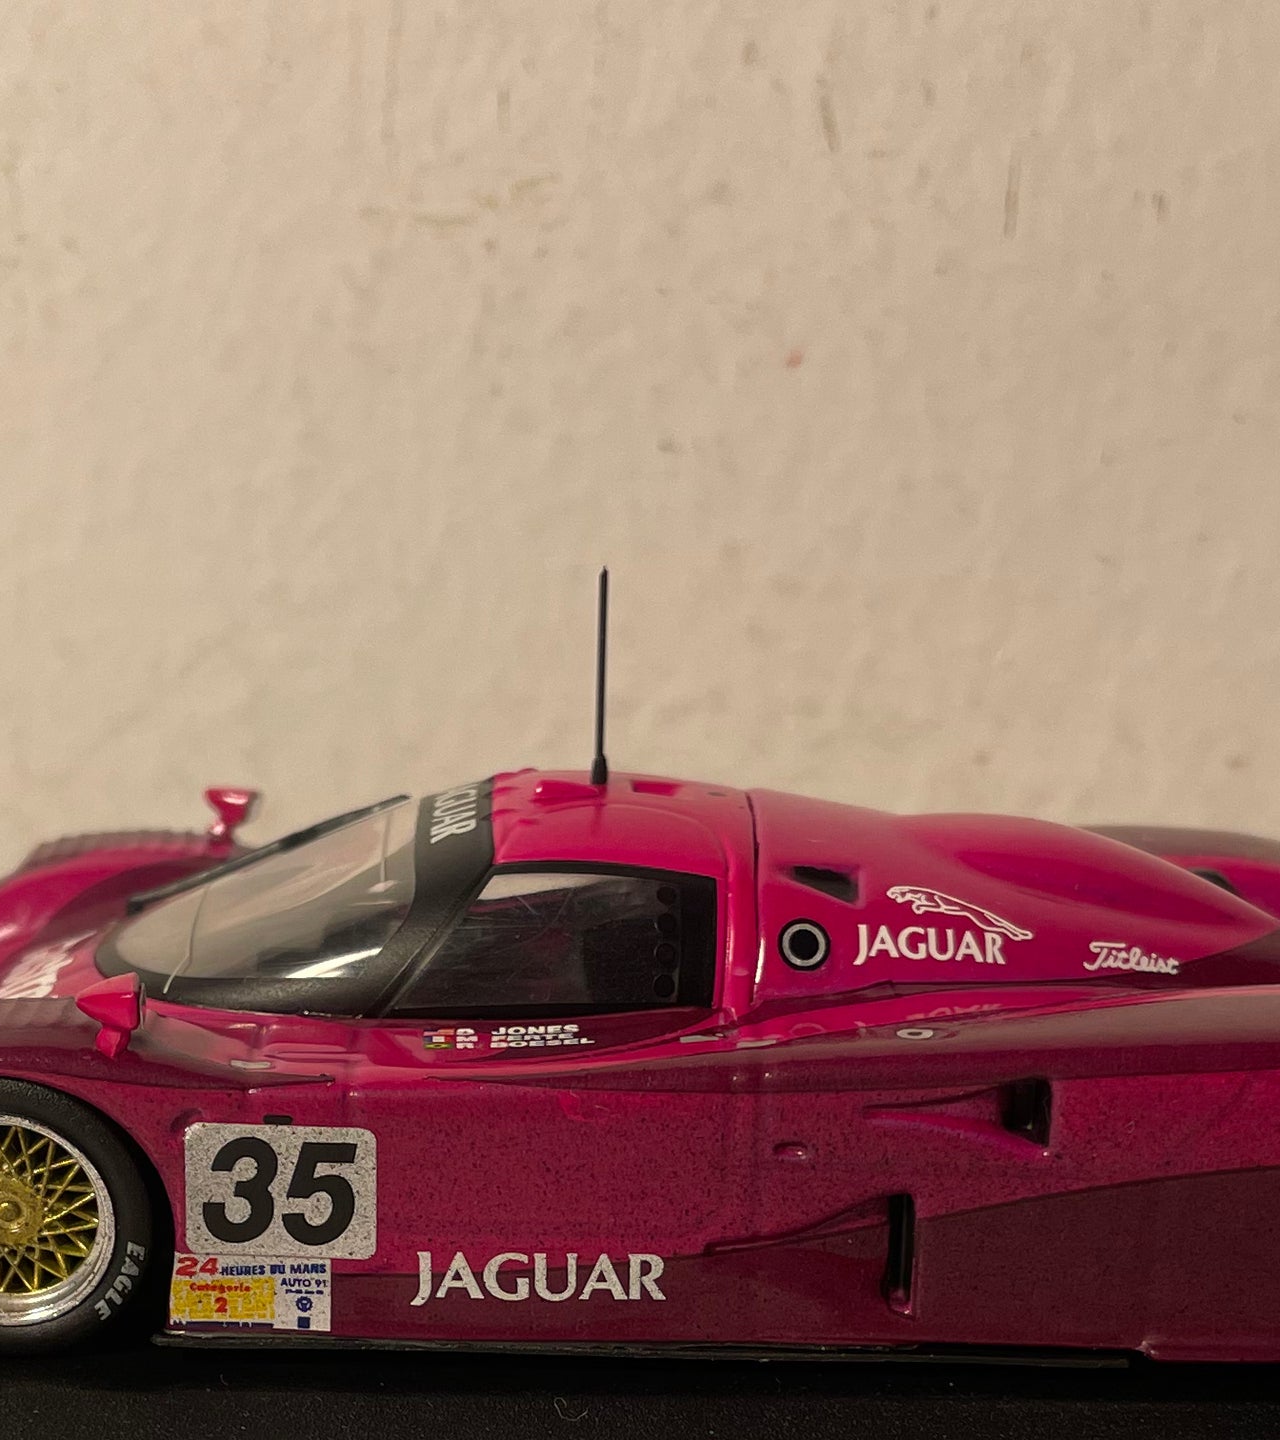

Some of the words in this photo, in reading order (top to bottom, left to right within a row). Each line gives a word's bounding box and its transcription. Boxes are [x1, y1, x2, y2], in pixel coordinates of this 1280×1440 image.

[429, 783, 478, 845] GUAR
[852, 923, 1007, 966] JAGUAR
[1082, 940, 1180, 976] Titleist
[489, 1036, 596, 1049] BOESEL
[490, 1023, 580, 1036] JONES
[201, 1136, 358, 1246] 35
[94, 1241, 146, 1321] EAGLE
[174, 1256, 219, 1277] 24
[220, 1265, 266, 1276] HEURES
[289, 1263, 327, 1274] MANS
[280, 1277, 312, 1288] AUTO
[409, 1250, 667, 1306] JAGUAR
[213, 1296, 228, 1314] 2
